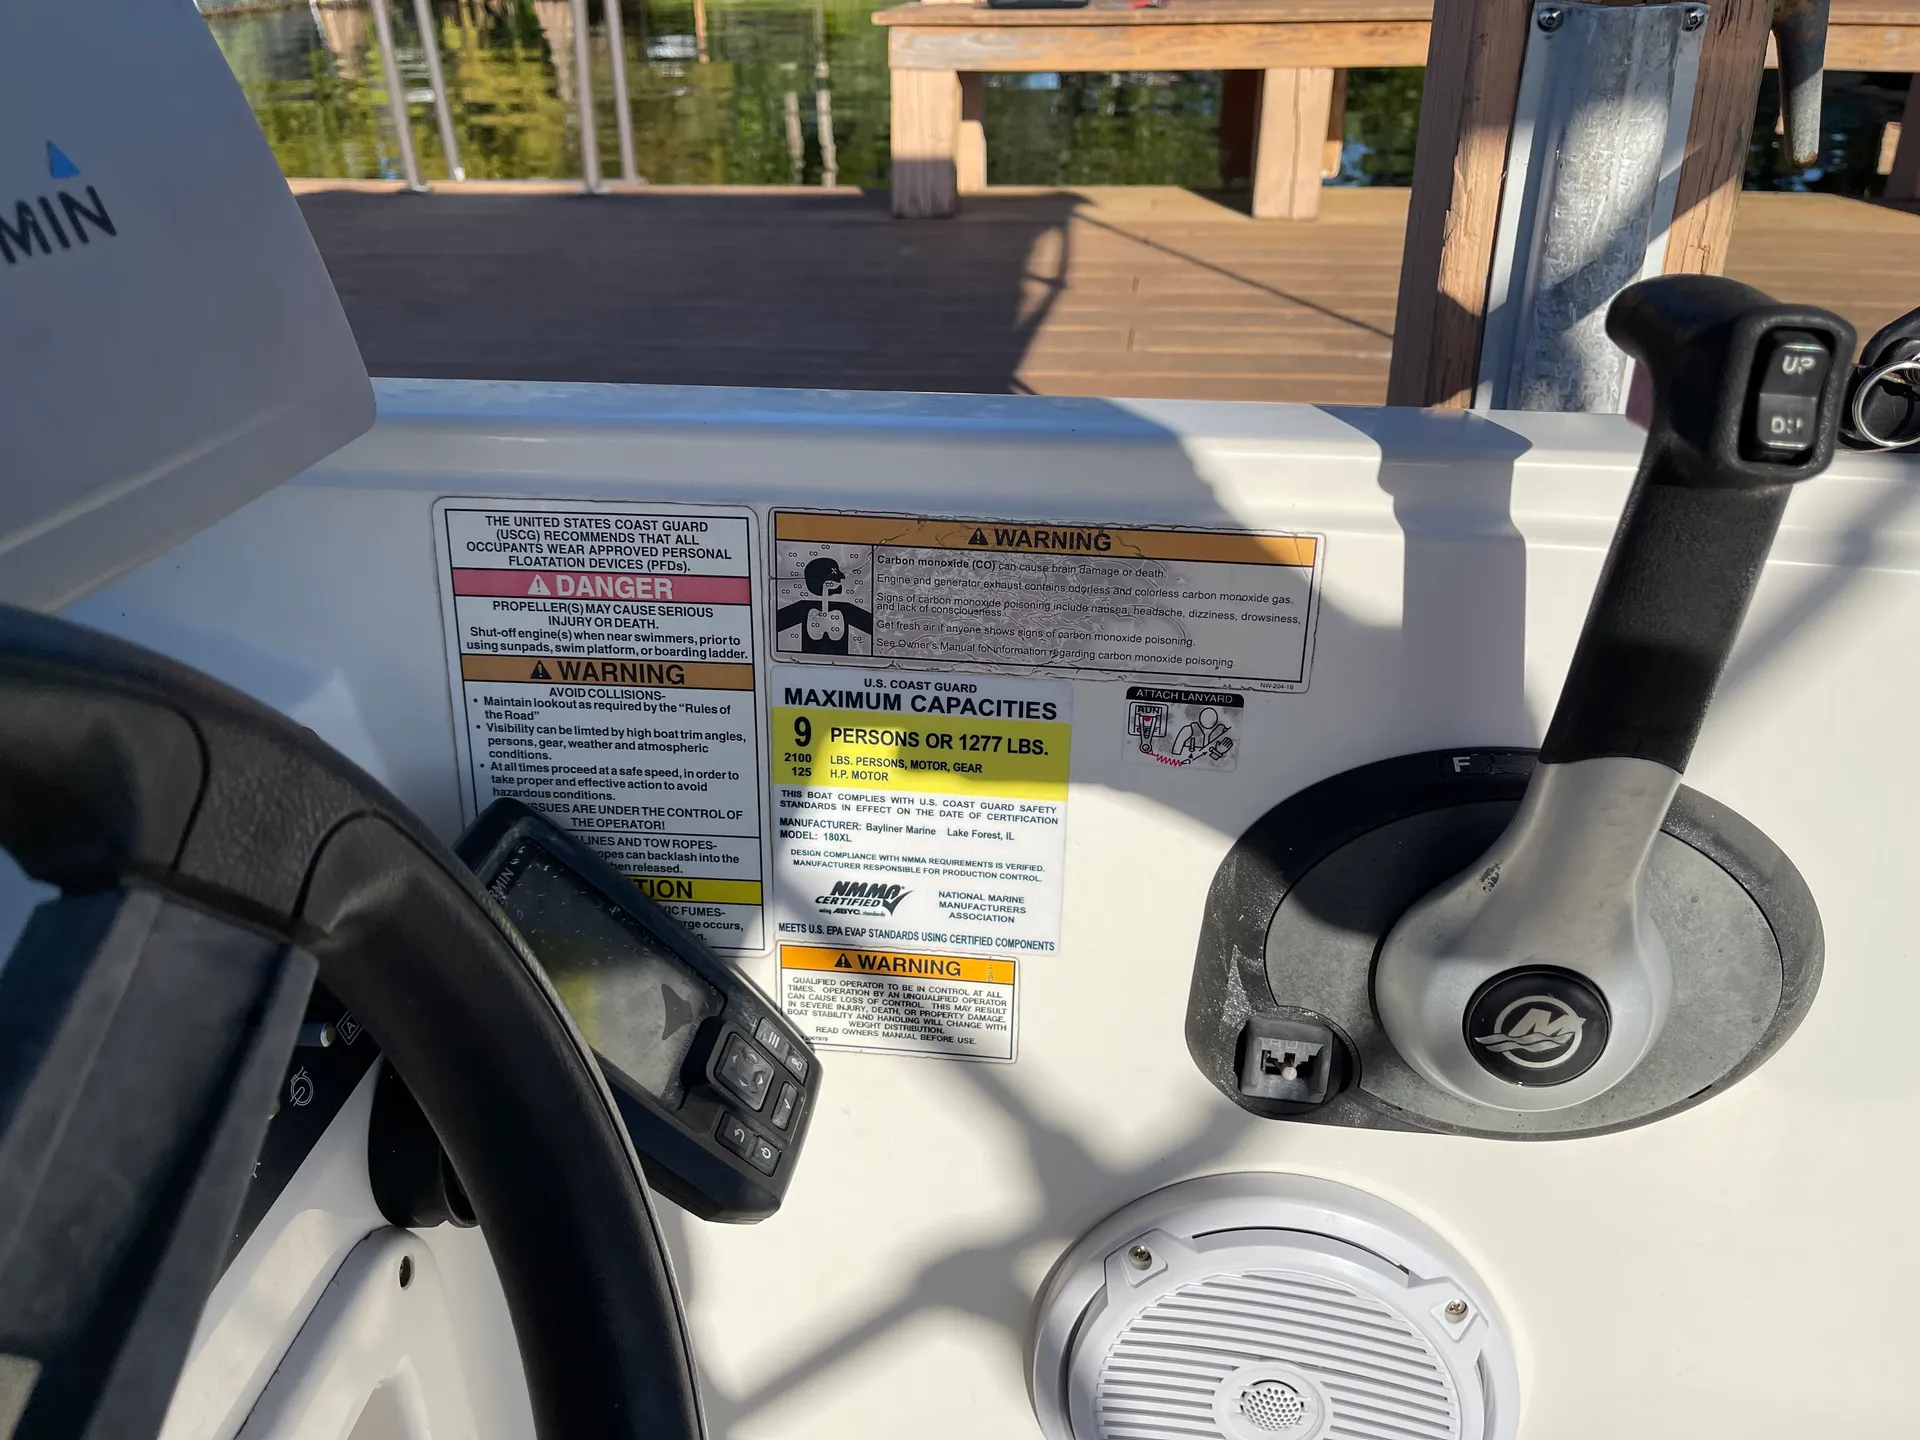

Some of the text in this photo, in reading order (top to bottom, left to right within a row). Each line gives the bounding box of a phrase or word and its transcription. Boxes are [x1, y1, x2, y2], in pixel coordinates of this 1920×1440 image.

[1782, 356, 1816, 375] UP
[484, 515, 708, 532] THE UNITED STATES COAST GUARD
[496, 529, 699, 546] (USCG) RECOMMENDS THAT ALL
[994, 529, 1110, 551] WARNING
[467, 541, 731, 560] OCCUPANTS WEAR APPROVED PERSONAL
[509, 556, 691, 573] FLOATATION DEVICES (PFDs).
[877, 554, 914, 565] Carbon
[918, 557, 968, 567] monoxide
[972, 559, 995, 571] (CO)
[998, 562, 1016, 571] can
[1019, 564, 1048, 572] cause
[1051, 564, 1075, 573] brain
[1078, 564, 1119, 577] damage
[1135, 567, 1168, 578] death.
[555, 574, 672, 599] DANGER
[877, 574, 1294, 606] Engine and generator exhaust contains odorless and colorless carbon monoxide gas.
[492, 601, 713, 617] PROPELLER(S) MAY CAUSE SERIOUS
[548, 616, 658, 629] INJURY OR DEATH.
[470, 626, 740, 647] Shut-off engine(s) when near swimmers, prior to
[466, 641, 747, 659] using sunpads, swim platform, or boarding ladder.
[557, 660, 684, 685] WARNING
[549, 687, 664, 701] AVOID COLLISIONS-
[864, 679, 977, 693] U.S. COAST GUARD
[483, 696, 531, 706] Maintain
[533, 698, 577, 708] lookout
[578, 701, 591, 709] as
[593, 700, 641, 713] required
[643, 701, 657, 713] by
[658, 702, 677, 712] the
[719, 704, 730, 714] of
[784, 687, 1056, 720] MAXIMUM CAPACITIES
[1136, 689, 1232, 703] ATTACH LANYARD
[485, 710, 538, 721] the Road”
[794, 716, 1047, 756] 9 PERSONS OR 1277 LBS.
[784, 752, 982, 774] 2100 LBS. PERSONS, MOTOR, GEAR
[1453, 757, 1470, 772] F
[791, 767, 888, 781] 125 H.P. MOTOR
[780, 789, 1056, 814] THIS BOAT COMPLIES WITH U.S. COAST GUARD SAFETY
[778, 800, 1058, 824] STANDARDS IN EFFECT ON THE DATE OF CERTIFICATION
[778, 817, 936, 837] MANUFACTURER: Bayliner Marine
[778, 830, 851, 842] MODEL: 180XL
[947, 827, 1014, 841] Lake Forest, IL
[830, 880, 900, 899] NMMA
[938, 891, 1024, 903] NATIONAL MARINE
[815, 896, 880, 908] CERTIFIED
[939, 901, 1026, 914] MANUFACTURERS
[948, 912, 1014, 923] ASSOCIATION
[779, 922, 1054, 952] MEETS U.S. EPA EVAP STANDARDS USING CERTIFIED COMPONENTS
[856, 955, 960, 976] WARNING
[793, 977, 1002, 998] QUALIFIED OPERATOR TO BE IN CONTROL AT ALL
[816, 1027, 976, 1045] READ OWNERS MANUAL BEFORE USE.
